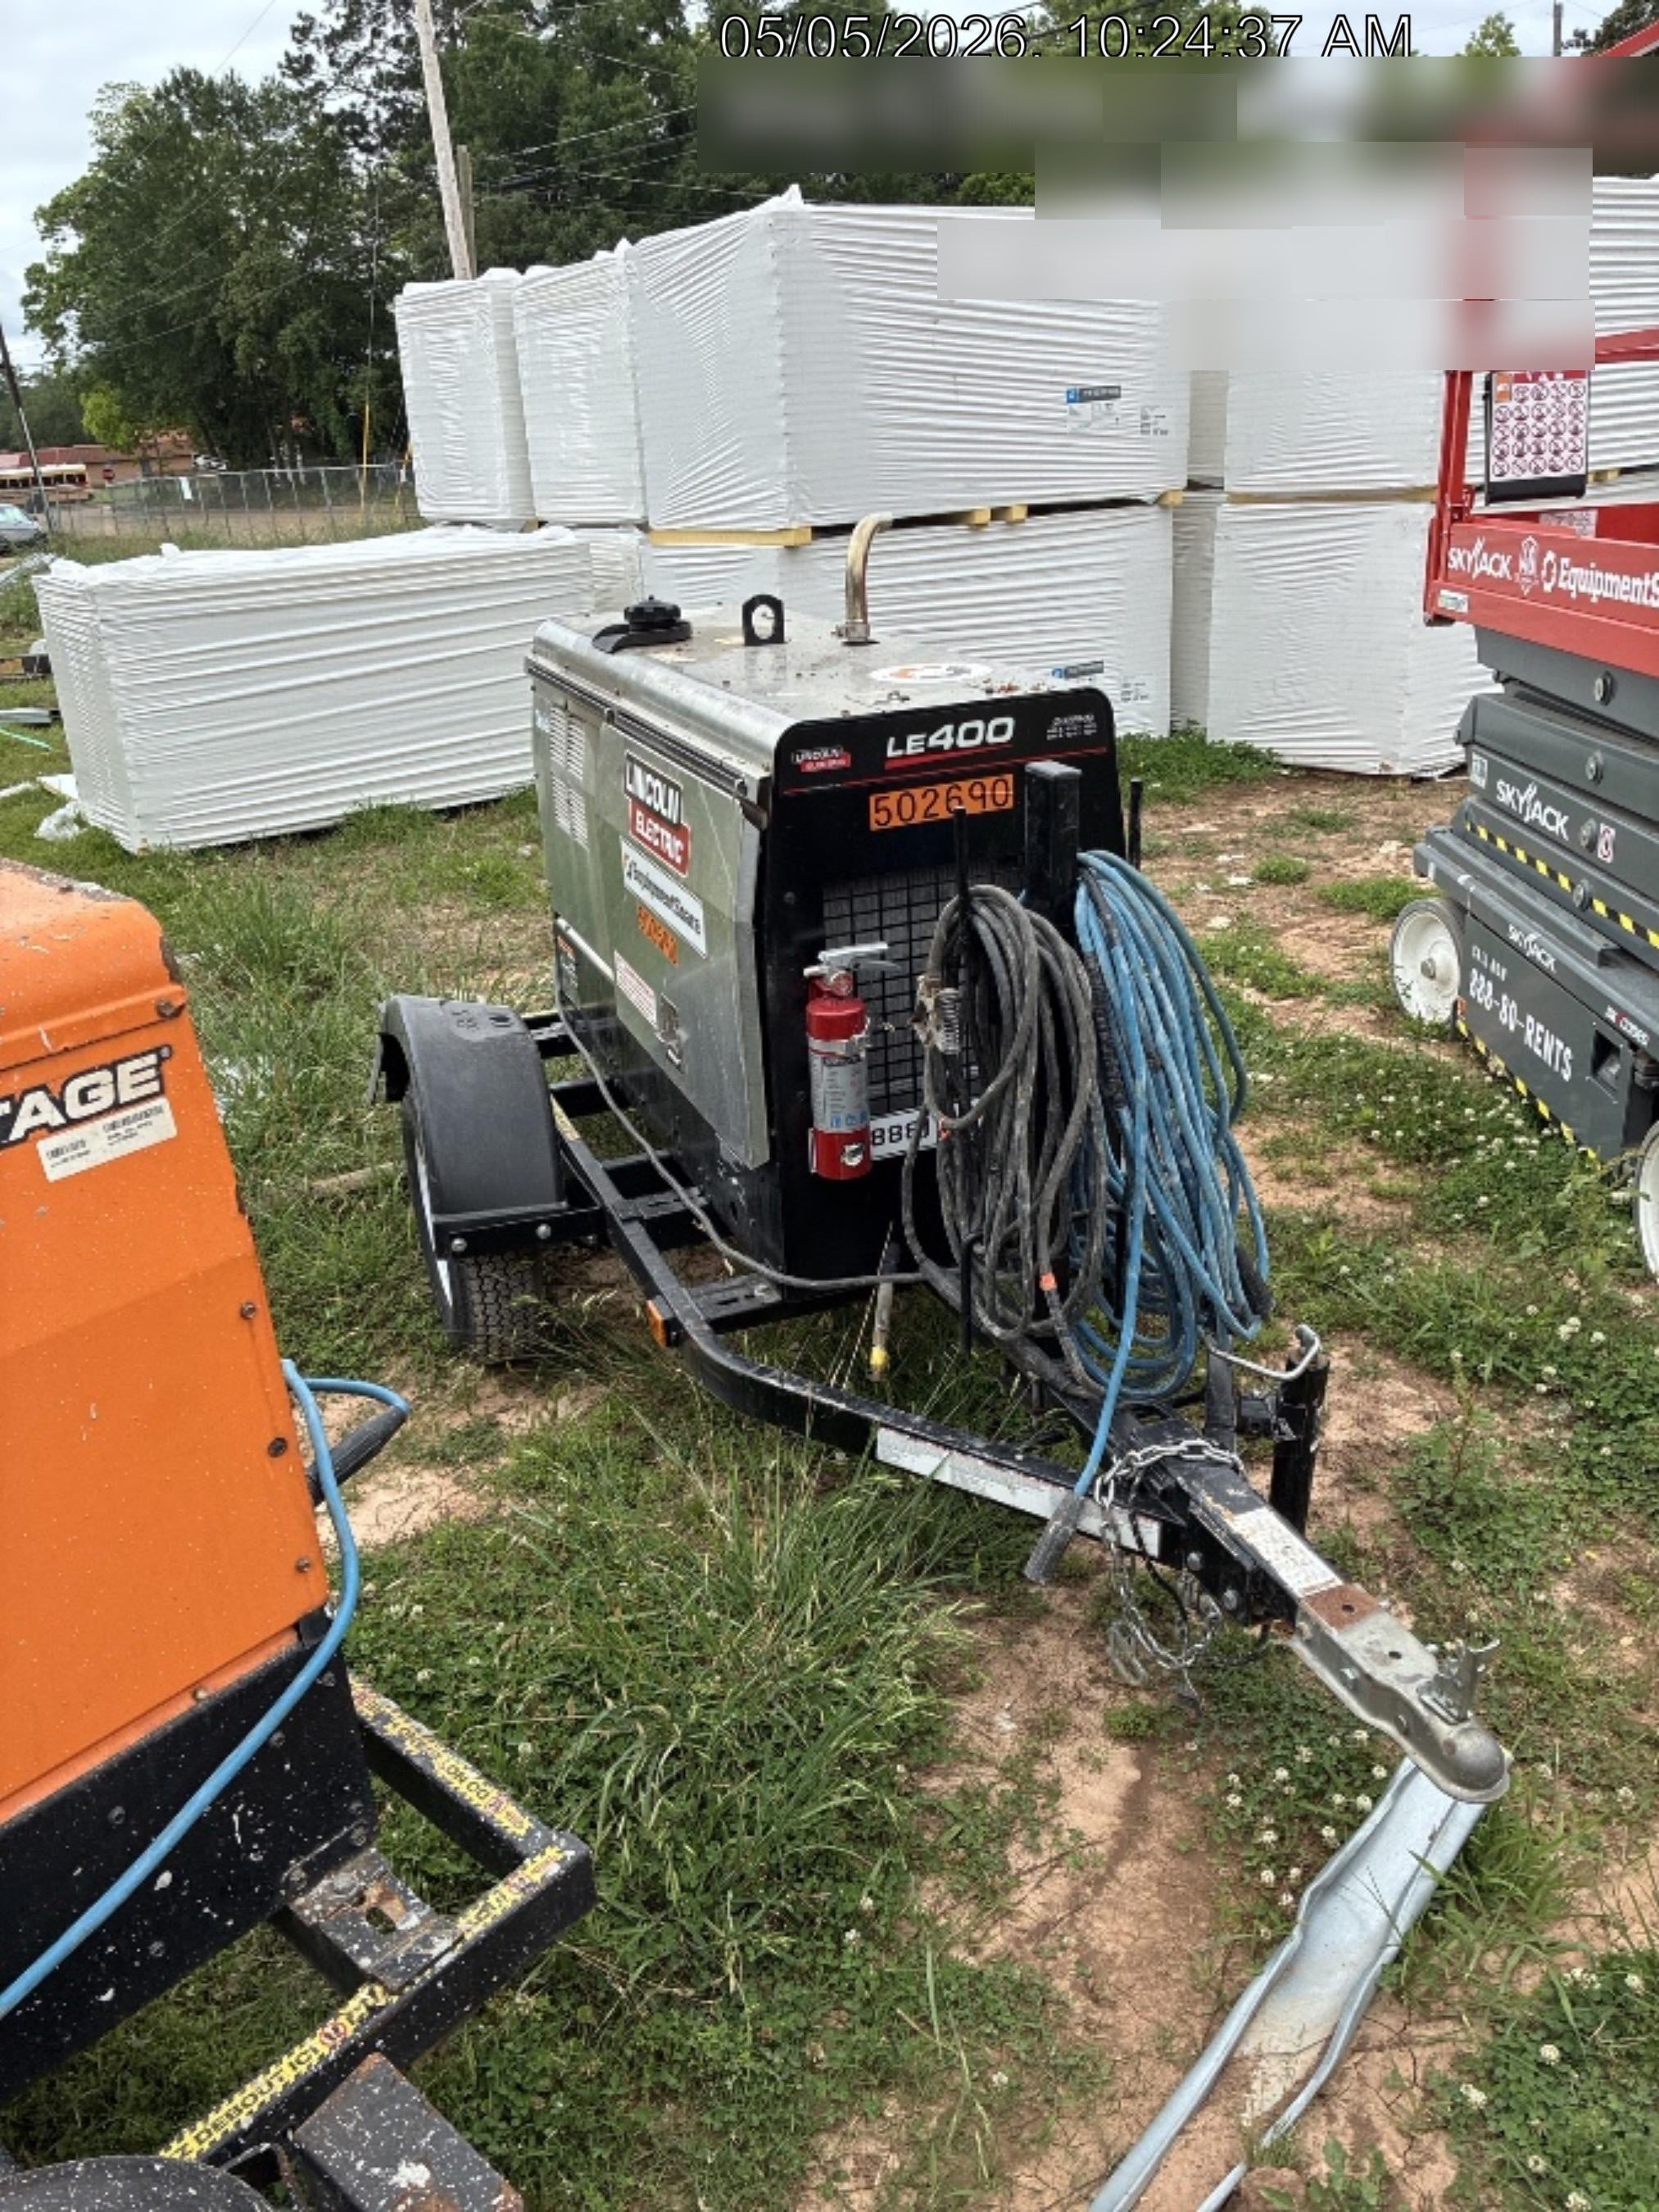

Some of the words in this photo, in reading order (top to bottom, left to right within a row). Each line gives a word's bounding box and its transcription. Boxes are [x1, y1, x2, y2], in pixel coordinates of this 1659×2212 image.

[1448, 537, 1512, 580] SKYJACK
[886, 717, 1015, 758] LE400
[627, 762, 679, 824] LINCOLN
[874, 778, 1009, 826] 502690
[1497, 779, 1569, 841] SKYJACK
[636, 809, 684, 863] ELECTRIC
[1470, 968, 1572, 1082] 888-80-RENTS
